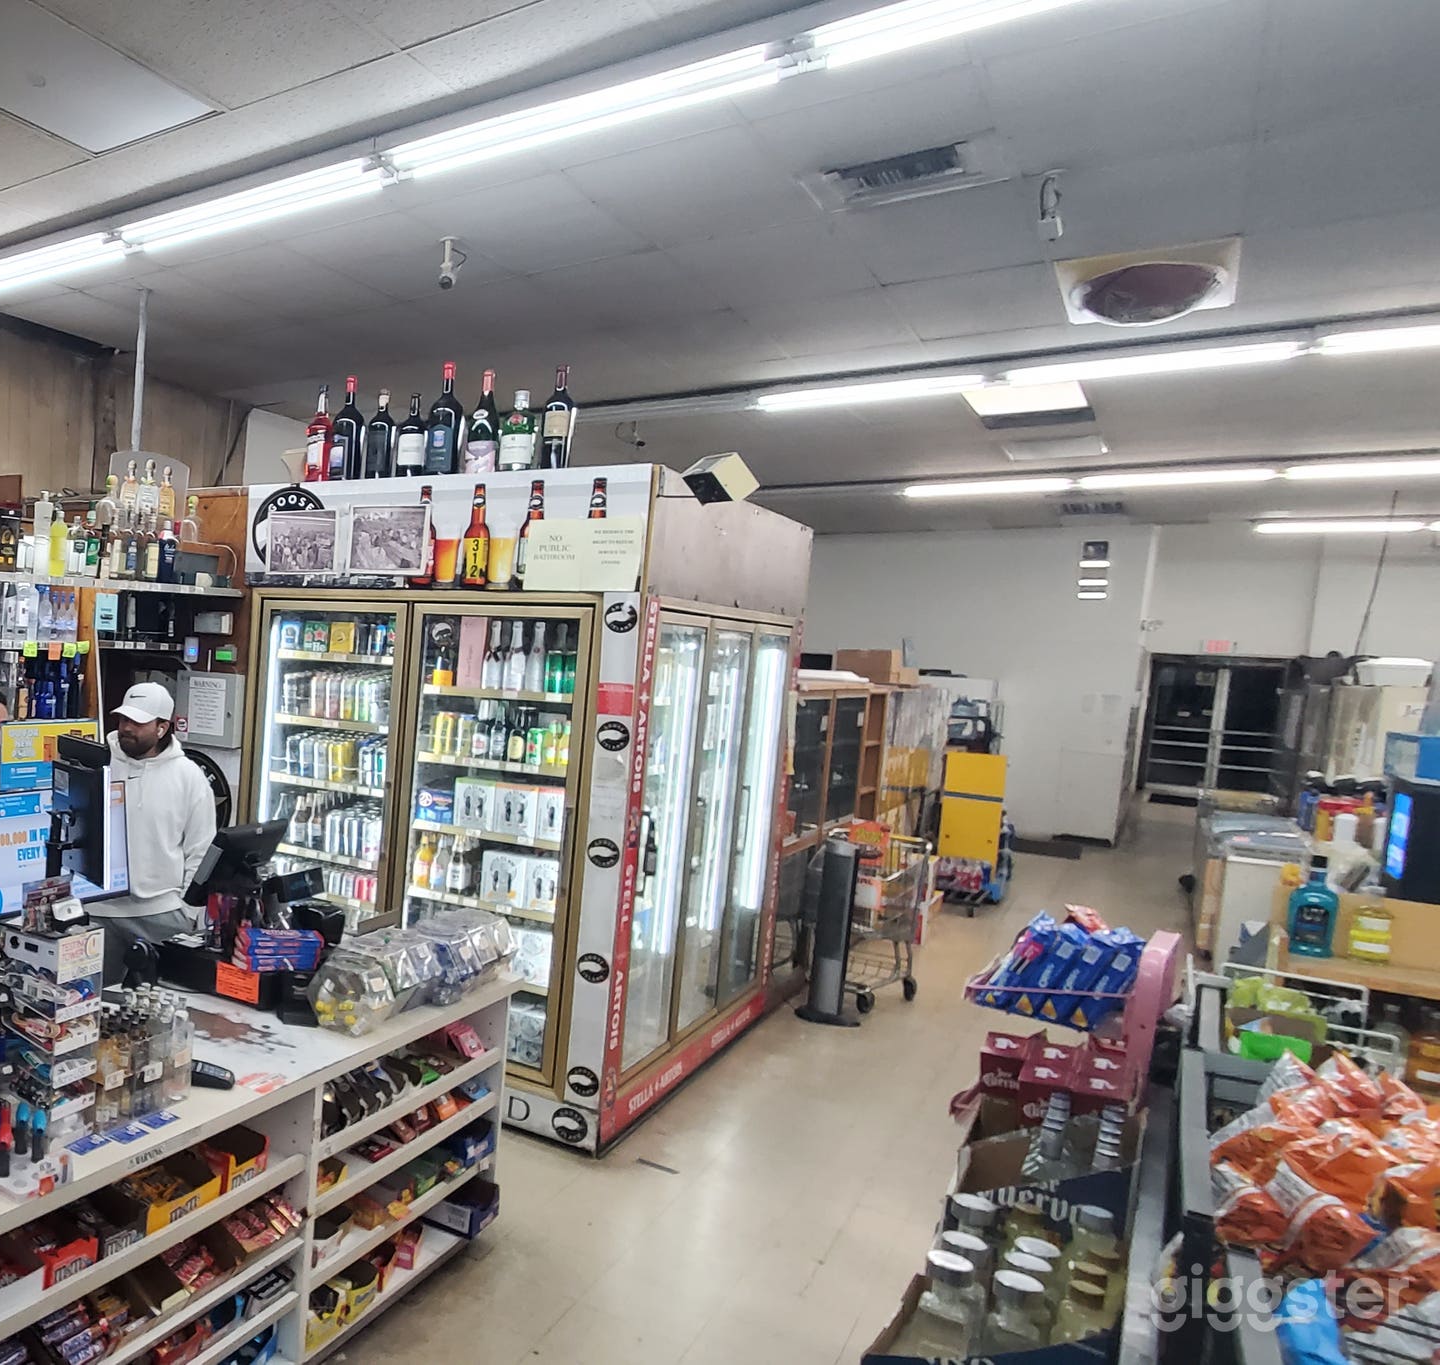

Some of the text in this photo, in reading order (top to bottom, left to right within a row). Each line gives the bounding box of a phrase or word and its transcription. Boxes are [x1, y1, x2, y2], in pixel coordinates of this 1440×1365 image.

[538, 544, 571, 552] PUBLIC
[632, 600, 659, 793] STELLA ARTOIS
[17, 847, 40, 861] EVERY
[610, 970, 624, 1051] ARTOIS
[628, 1089, 654, 1115] STELLA
